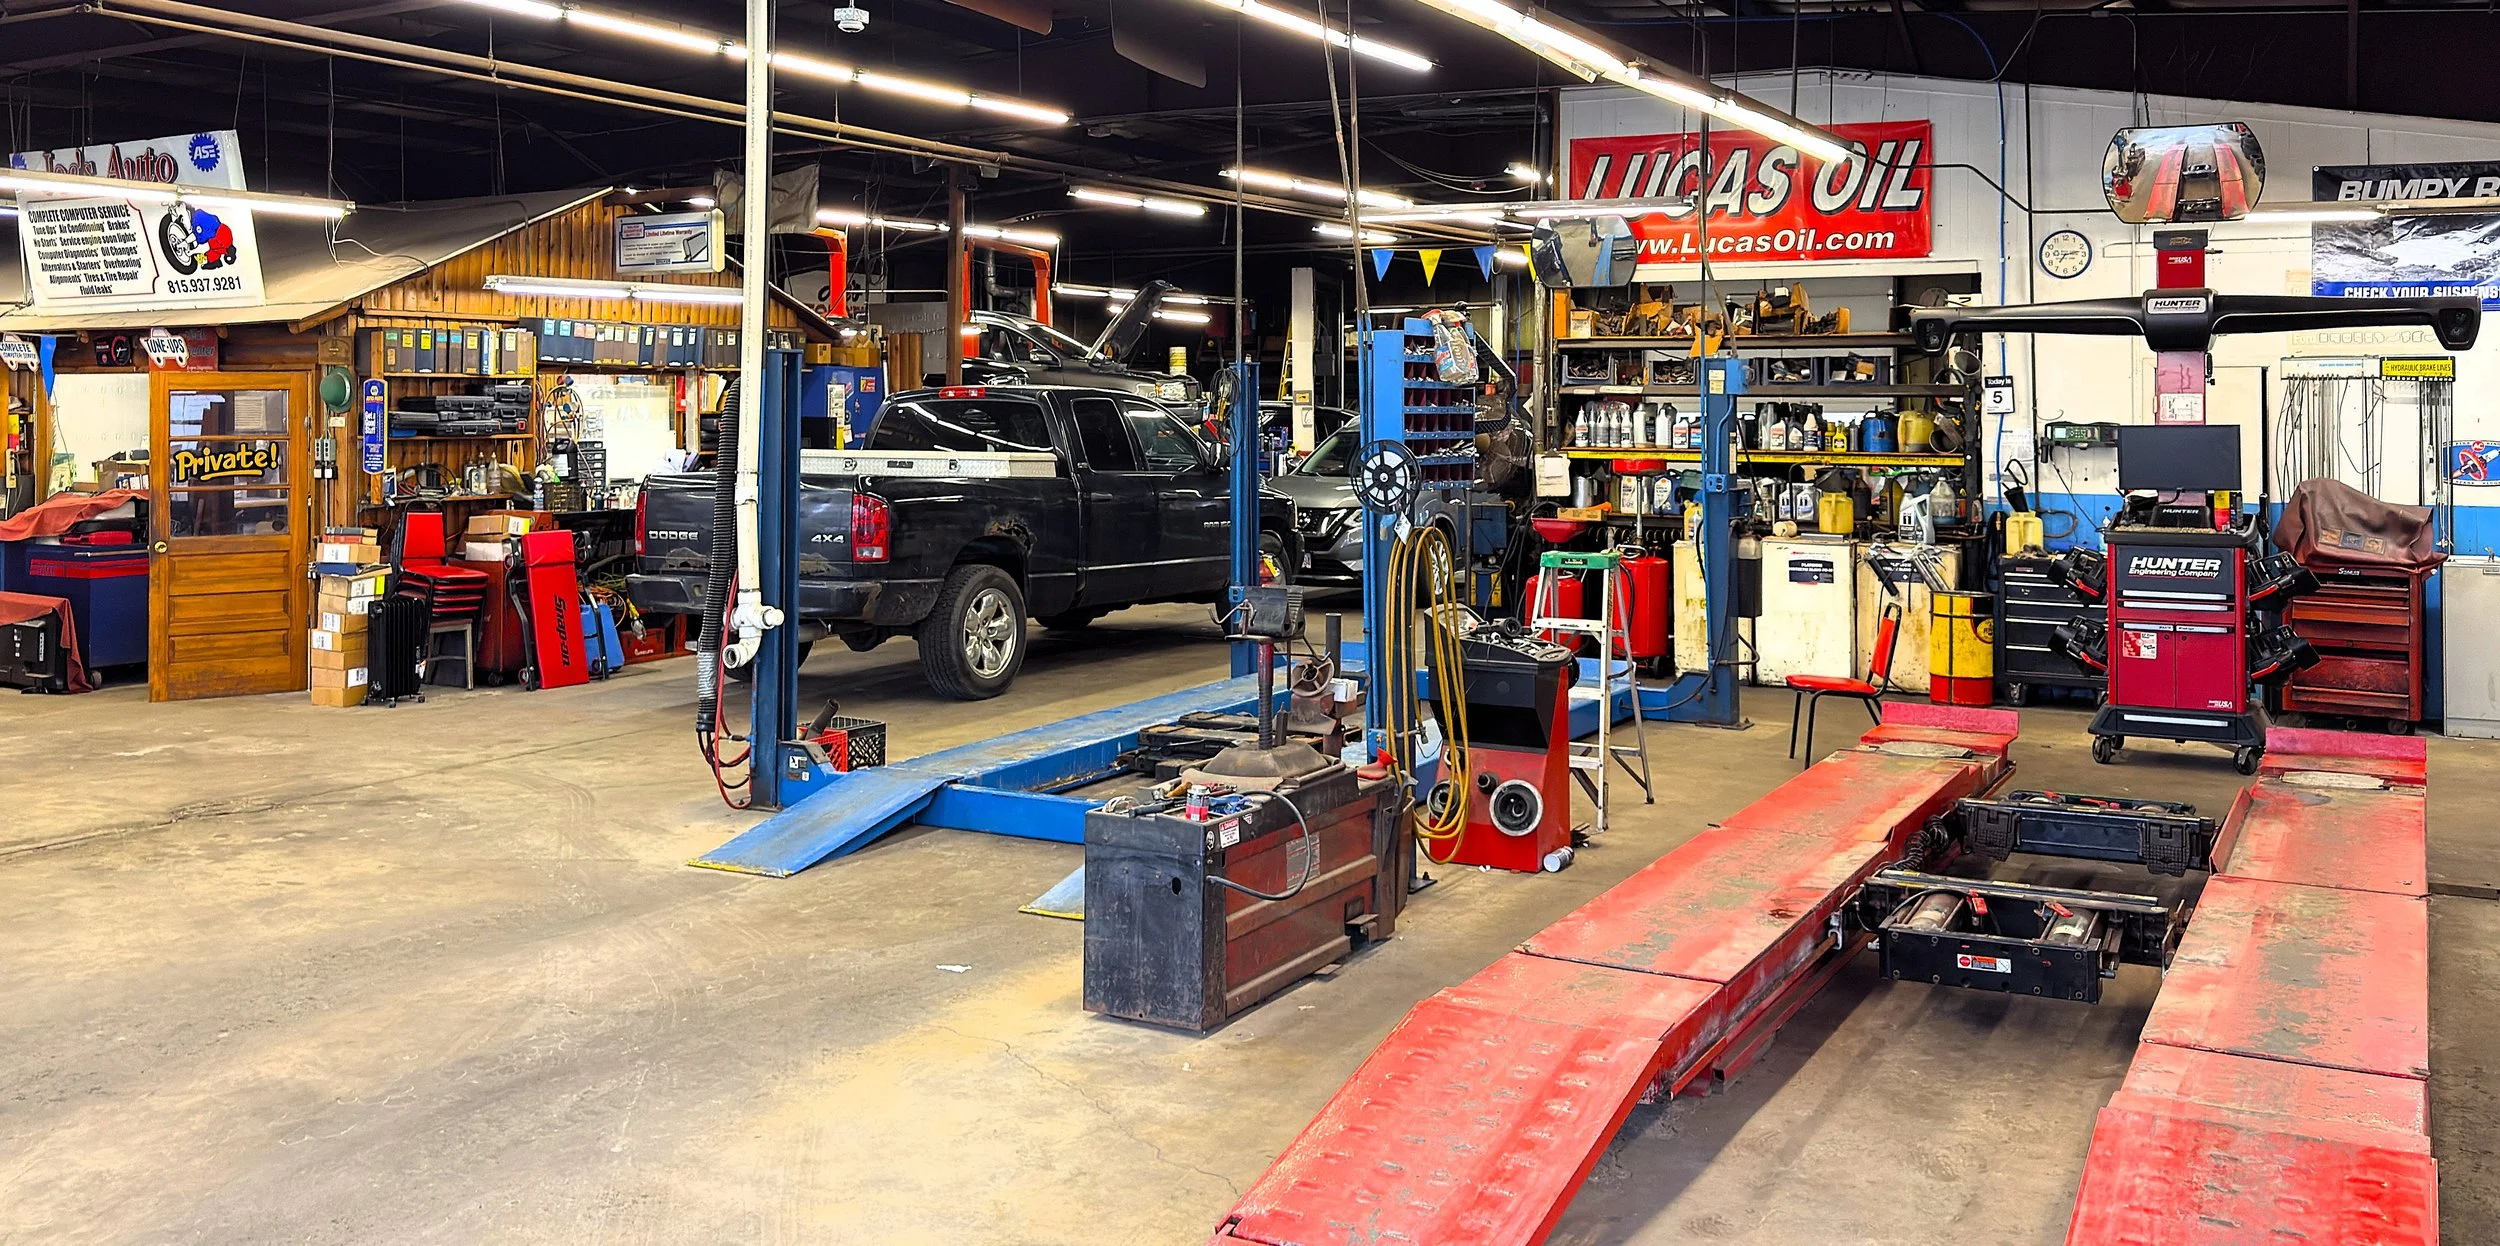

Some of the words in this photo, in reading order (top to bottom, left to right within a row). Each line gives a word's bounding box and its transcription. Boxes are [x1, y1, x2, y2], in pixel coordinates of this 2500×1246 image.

[193, 144, 217, 160] ASE
[107, 144, 177, 184] Auto
[1582, 141, 1798, 222] LUCAS
[1811, 138, 1925, 215] OIL
[2338, 177, 2469, 201] BUMPY
[2474, 176, 2500, 198] R
[28, 209, 60, 223] COMPLETE
[60, 207, 98, 221] COMPUTER
[98, 204, 130, 219] SERVICE
[33, 225, 46, 235] Tune
[59, 224, 67, 234] Air
[59, 236, 81, 247] Service
[81, 235, 102, 246] engine
[102, 235, 117, 244] soon
[38, 250, 64, 260] Computer
[101, 246, 110, 256] Oil
[84, 273, 100, 283] Tires
[105, 272, 117, 281] Tire
[80, 285, 96, 295] Fluid
[167, 276, 242, 293] 815.937.9281
[2344, 286, 2389, 298] CHECK
[2392, 286, 2429, 298] YOUR
[2433, 285, 2500, 298] SUSPENS
[2390, 364, 2419, 372] HYDRAULIC
[2419, 364, 2437, 372] BRAKE
[1993, 391, 2003, 403] 5
[174, 442, 278, 481] Private!
[649, 531, 698, 540] DODGE
[811, 534, 845, 543] 4X4
[2130, 556, 2222, 571] HUNTER
[2128, 567, 2177, 577] Engineering
[2178, 569, 2219, 578] Company
